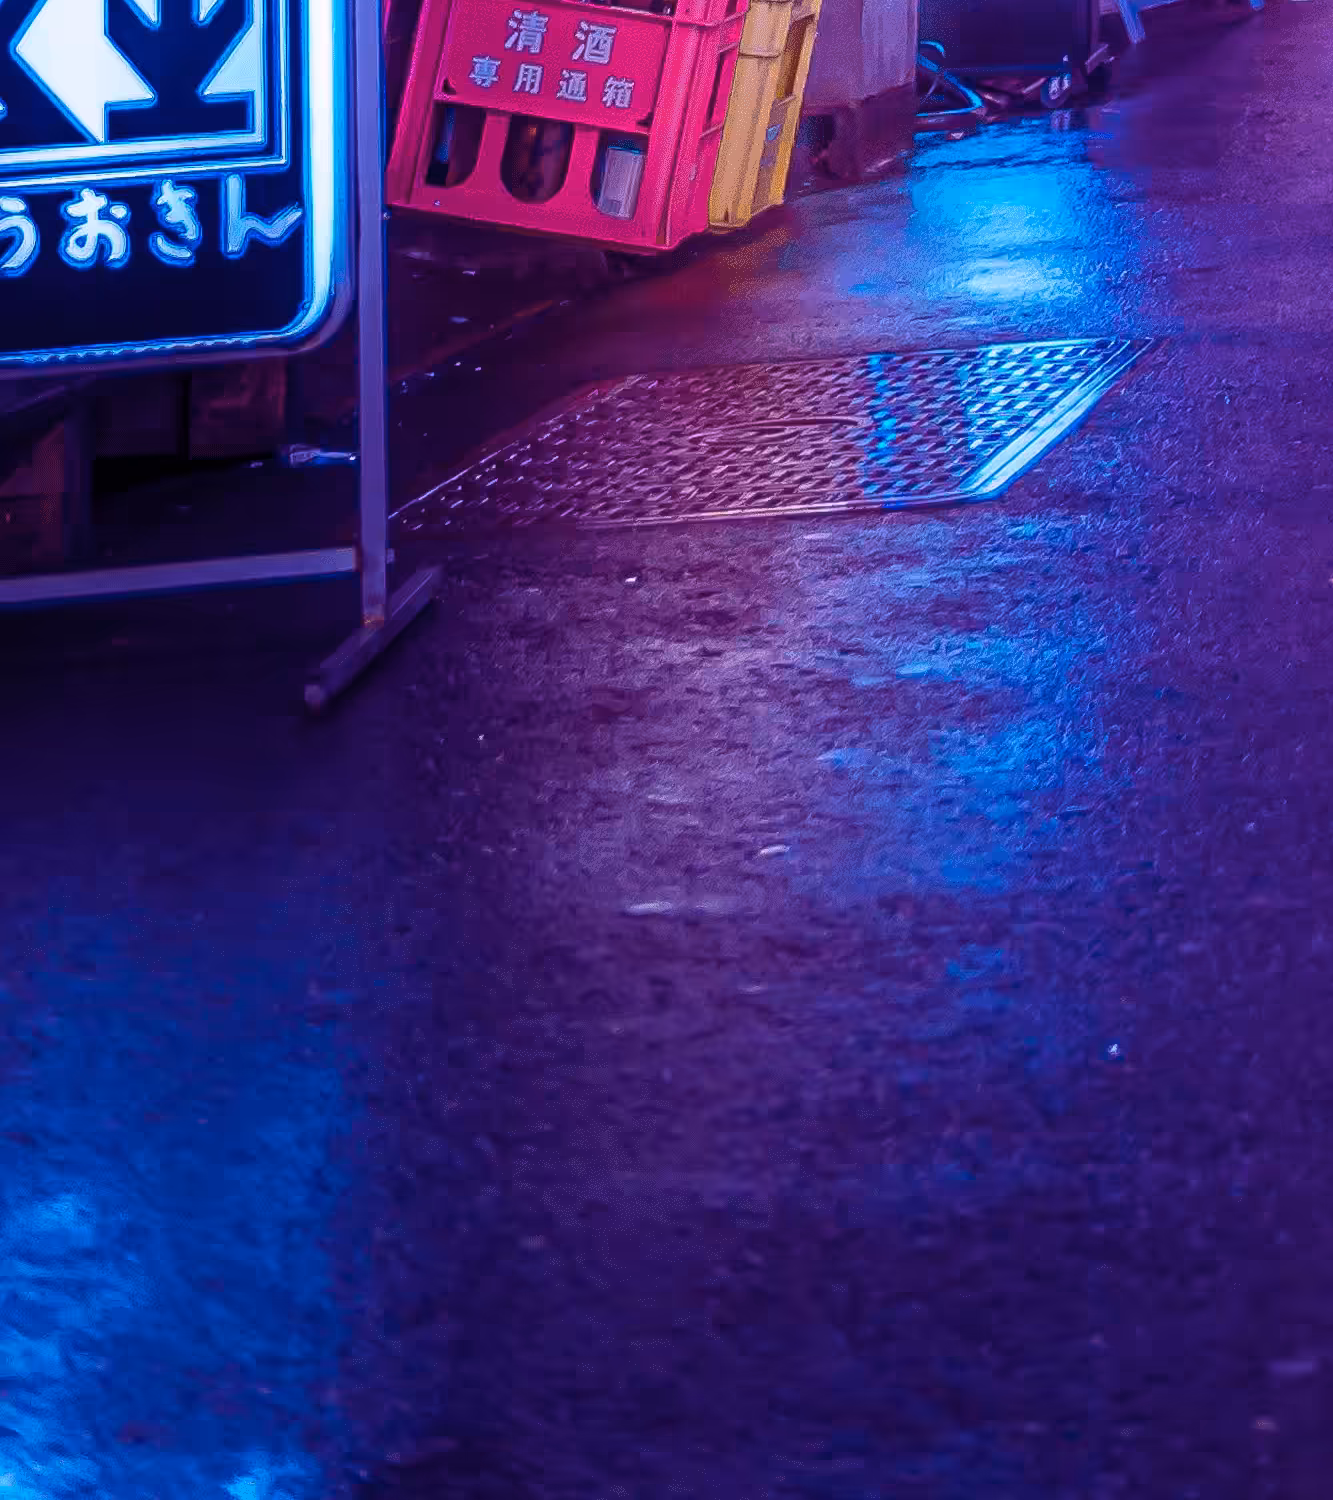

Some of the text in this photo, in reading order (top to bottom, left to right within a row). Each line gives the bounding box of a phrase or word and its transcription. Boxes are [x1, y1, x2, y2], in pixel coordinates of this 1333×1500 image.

[502, 7, 614, 68] 清酒
[468, 55, 636, 108] 専用通箱
